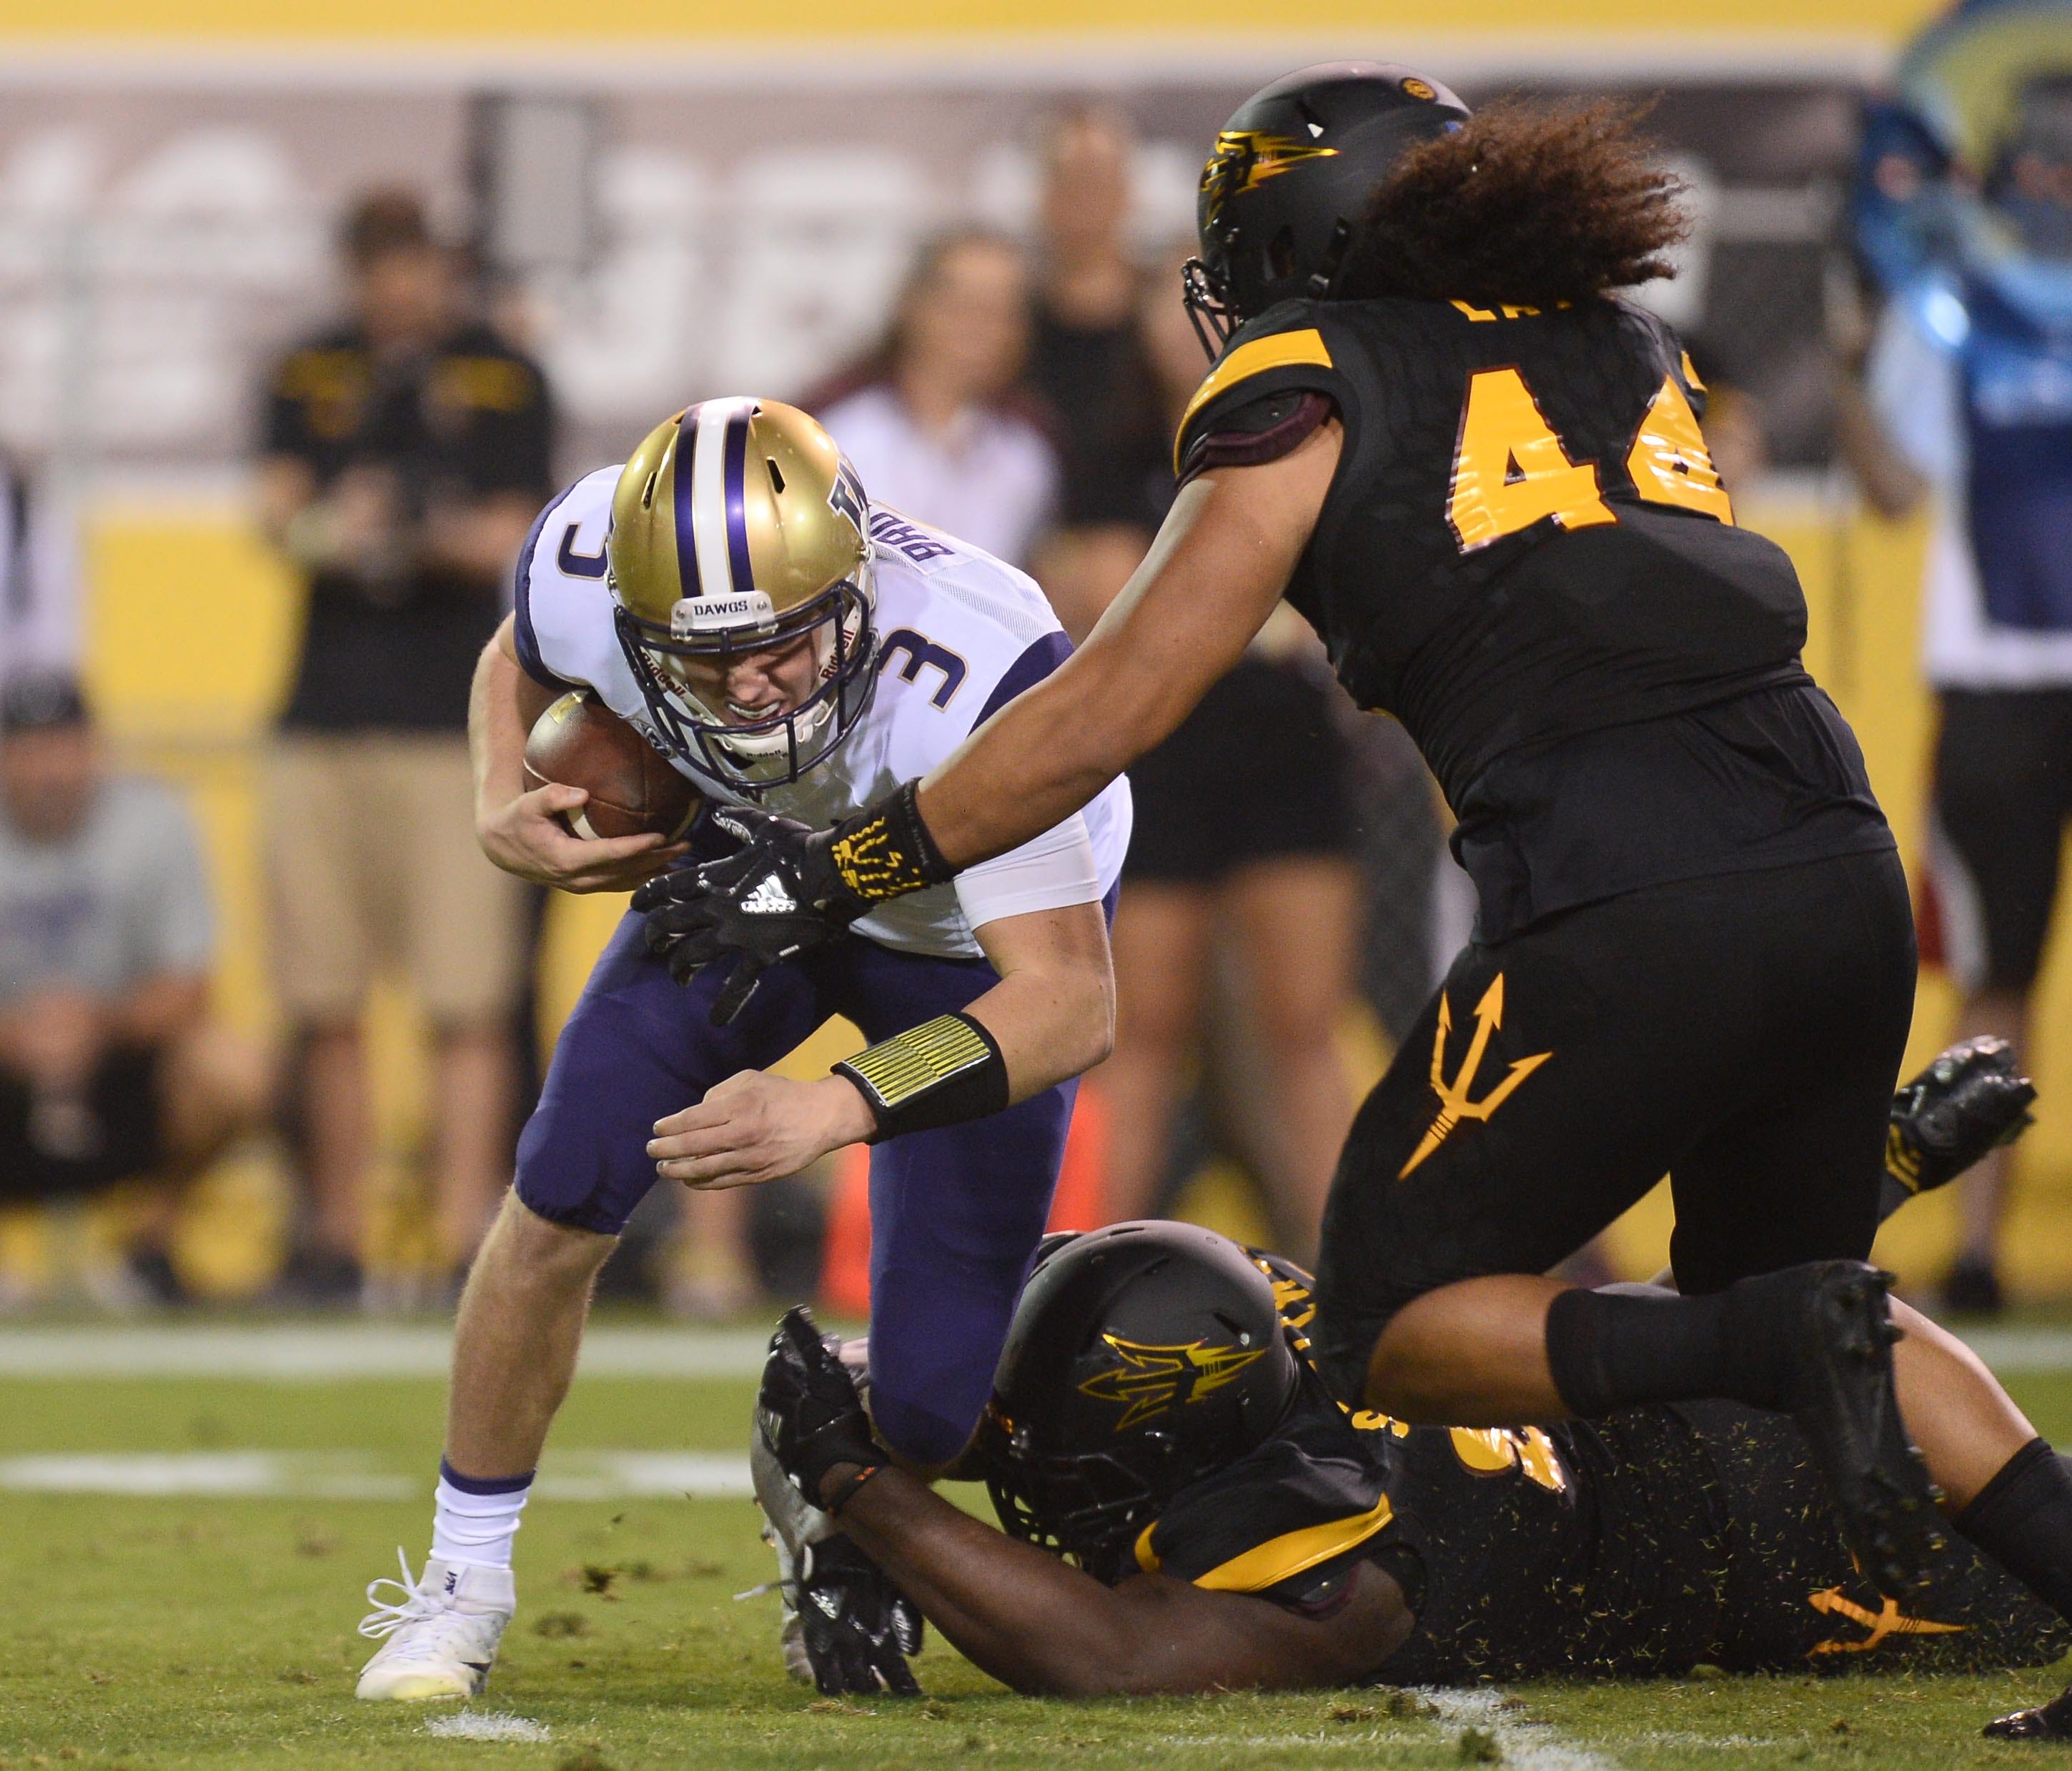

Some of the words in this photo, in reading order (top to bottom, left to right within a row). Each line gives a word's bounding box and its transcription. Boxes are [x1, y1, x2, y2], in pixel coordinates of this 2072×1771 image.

[1444, 363, 1737, 556] 44
[694, 600, 748, 615] DAWGS
[878, 626, 970, 713] 3
